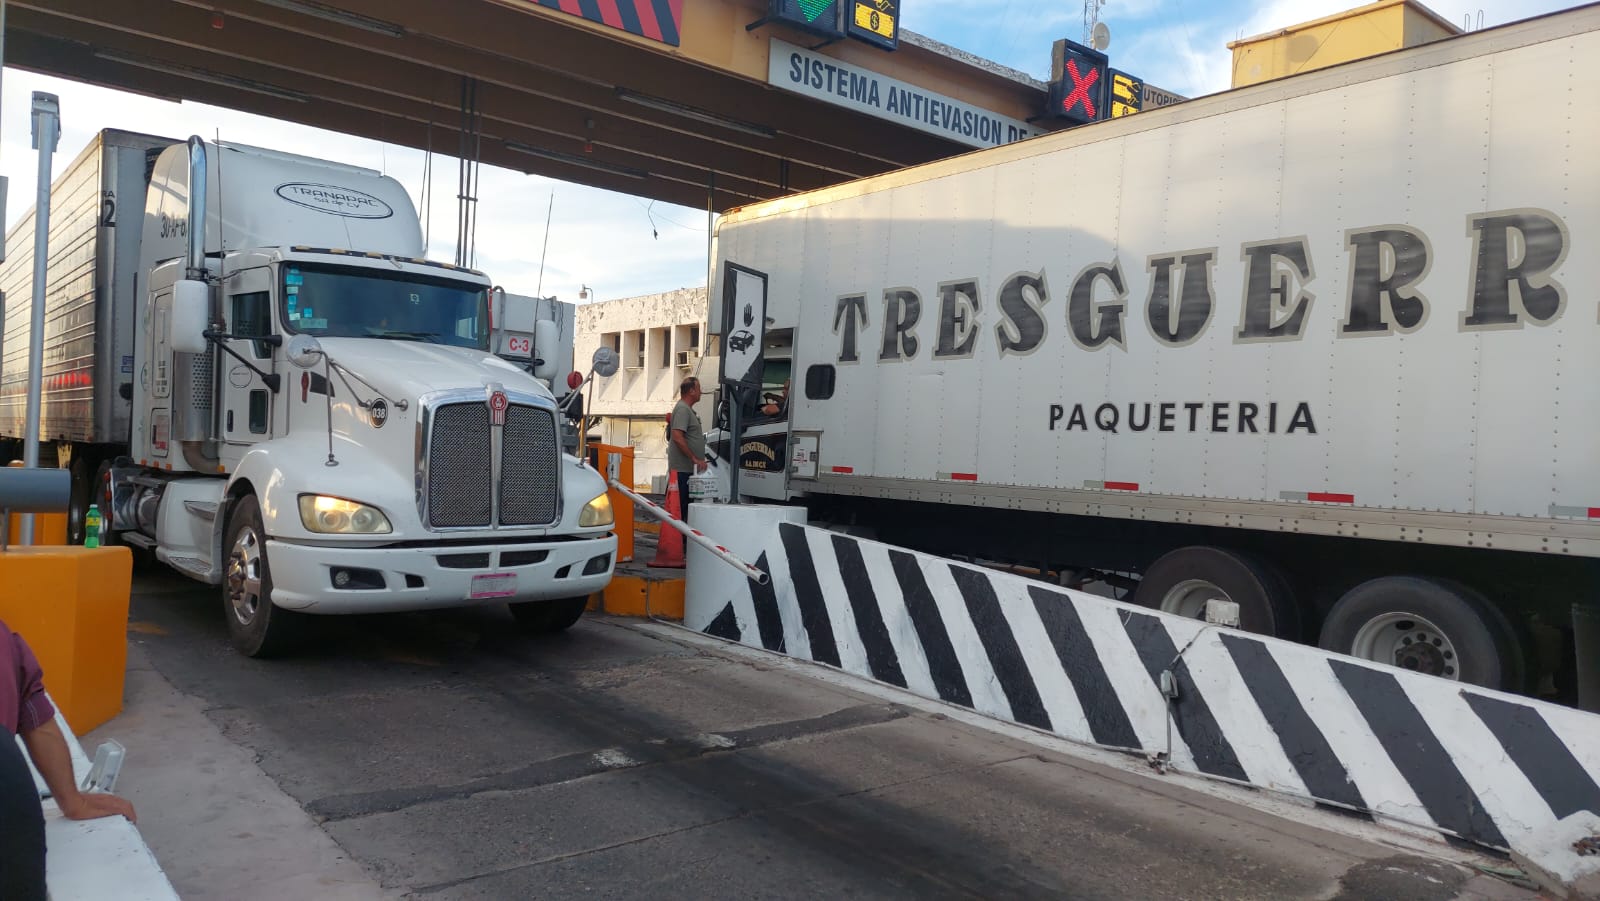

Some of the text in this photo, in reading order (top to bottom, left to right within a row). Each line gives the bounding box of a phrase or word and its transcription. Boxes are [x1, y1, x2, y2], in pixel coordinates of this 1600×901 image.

[789, 52, 880, 108] SISTEMA
[886, 86, 1002, 145] ANTIEVASION
[832, 207, 1600, 366] TRESGUERR
[1049, 401, 1318, 434] PAQUETERIA
